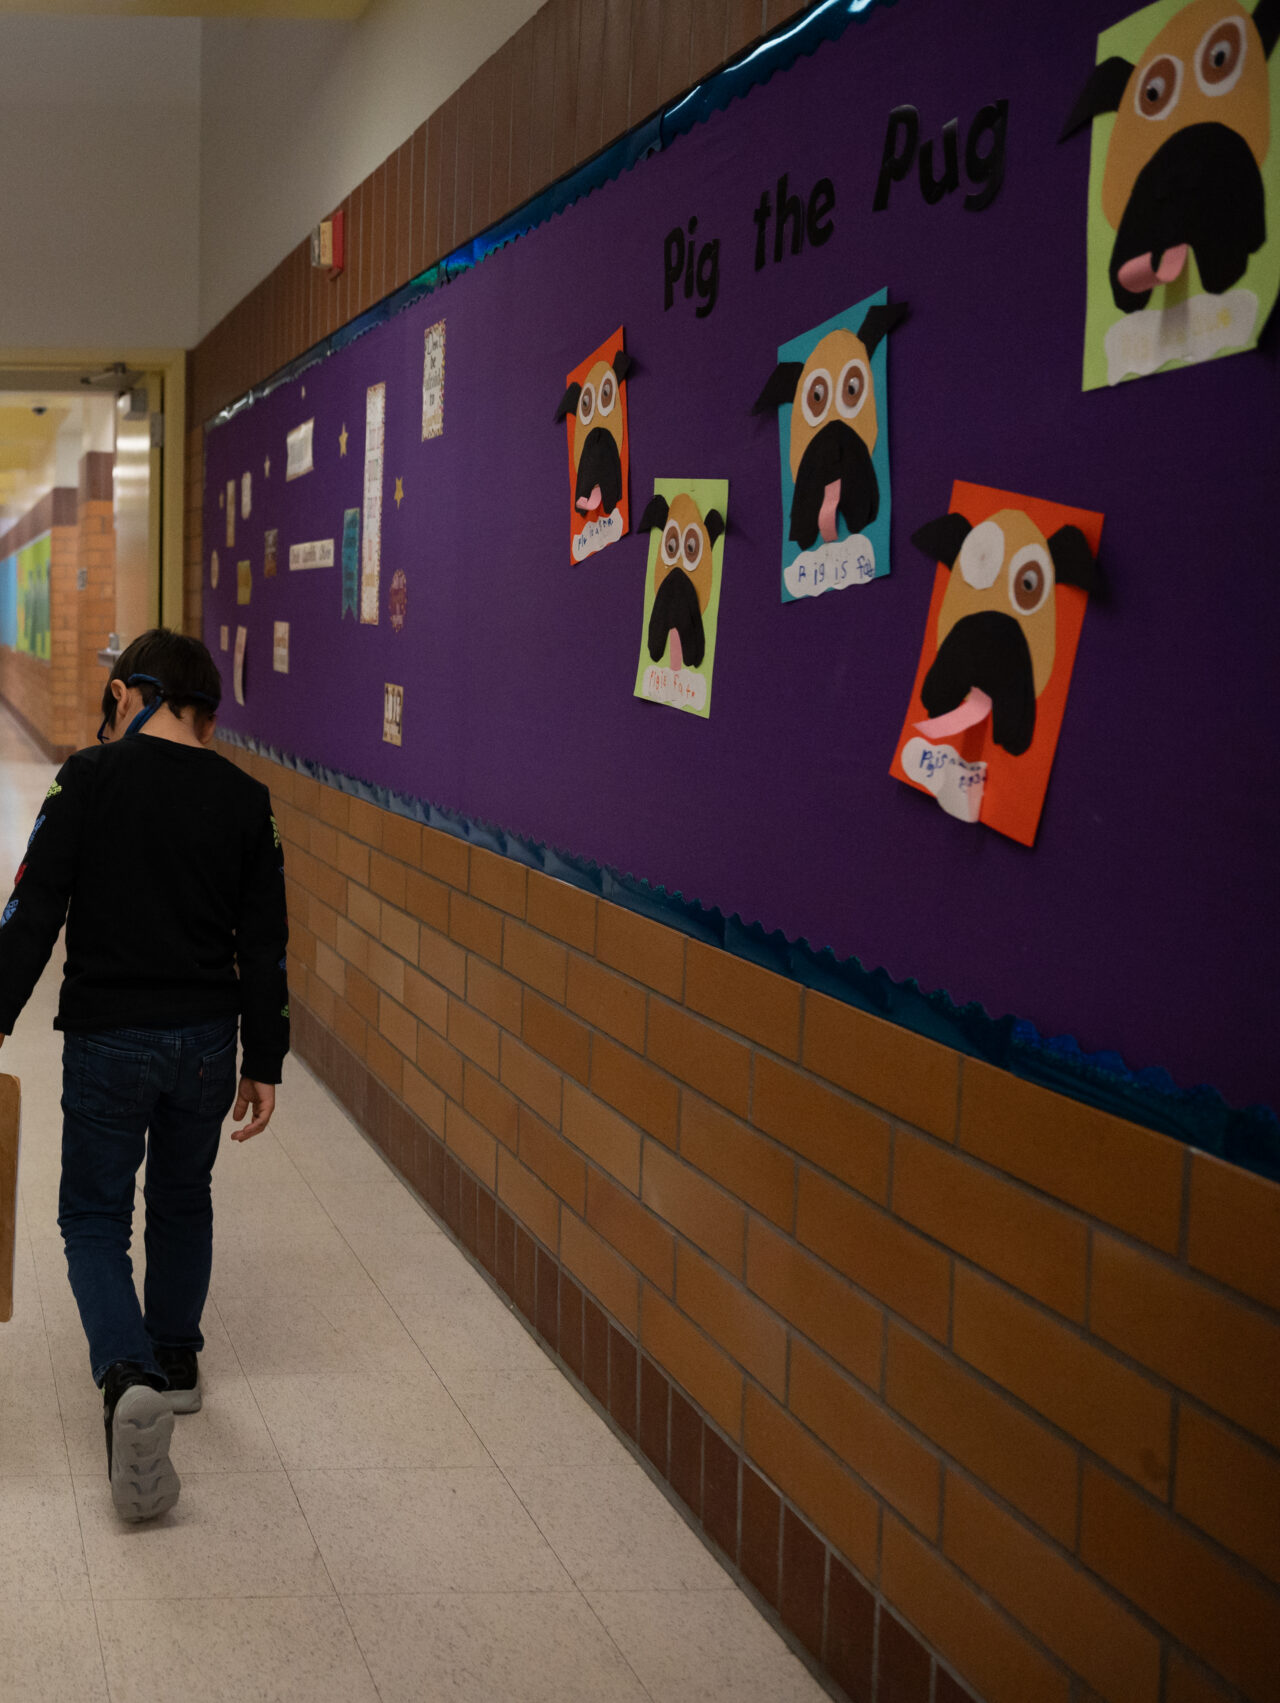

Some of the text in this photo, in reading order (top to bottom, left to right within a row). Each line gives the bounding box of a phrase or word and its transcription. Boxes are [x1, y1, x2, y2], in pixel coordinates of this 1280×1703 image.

[664, 99, 1010, 318] Pig the Pug
